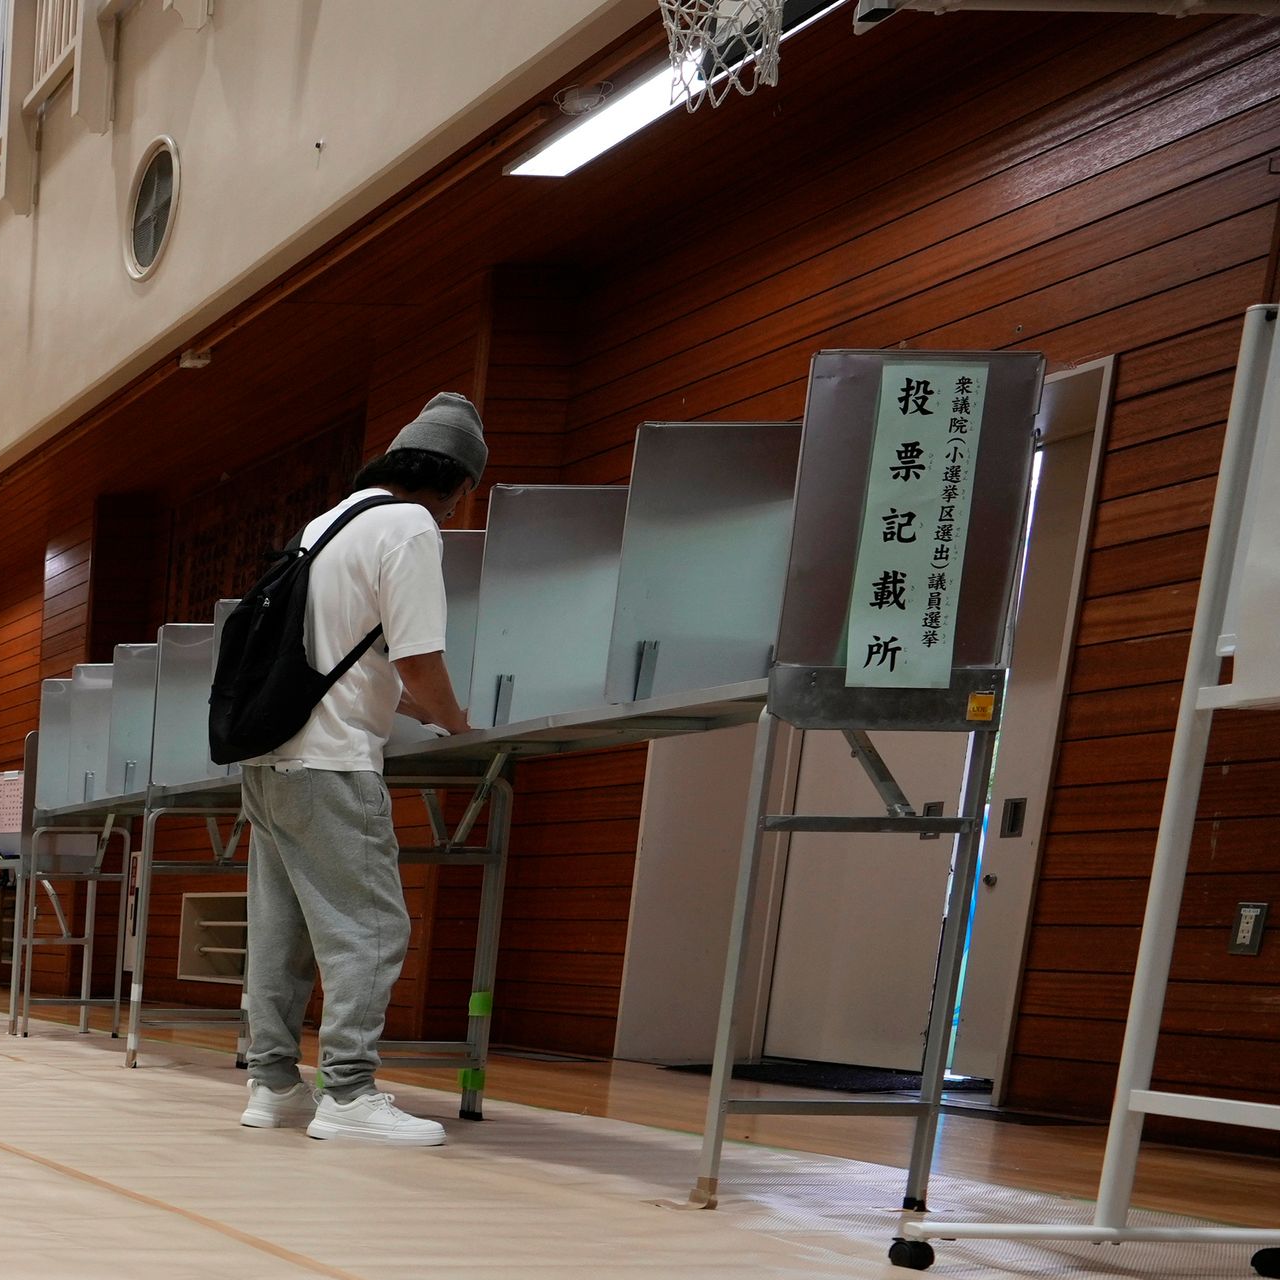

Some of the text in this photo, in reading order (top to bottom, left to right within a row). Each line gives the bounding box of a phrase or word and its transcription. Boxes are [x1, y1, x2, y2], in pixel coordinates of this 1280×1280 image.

[862, 377, 934, 672] 投票記載所
[921, 375, 974, 648] 衆議院（小選挙区選出）議員選挙
